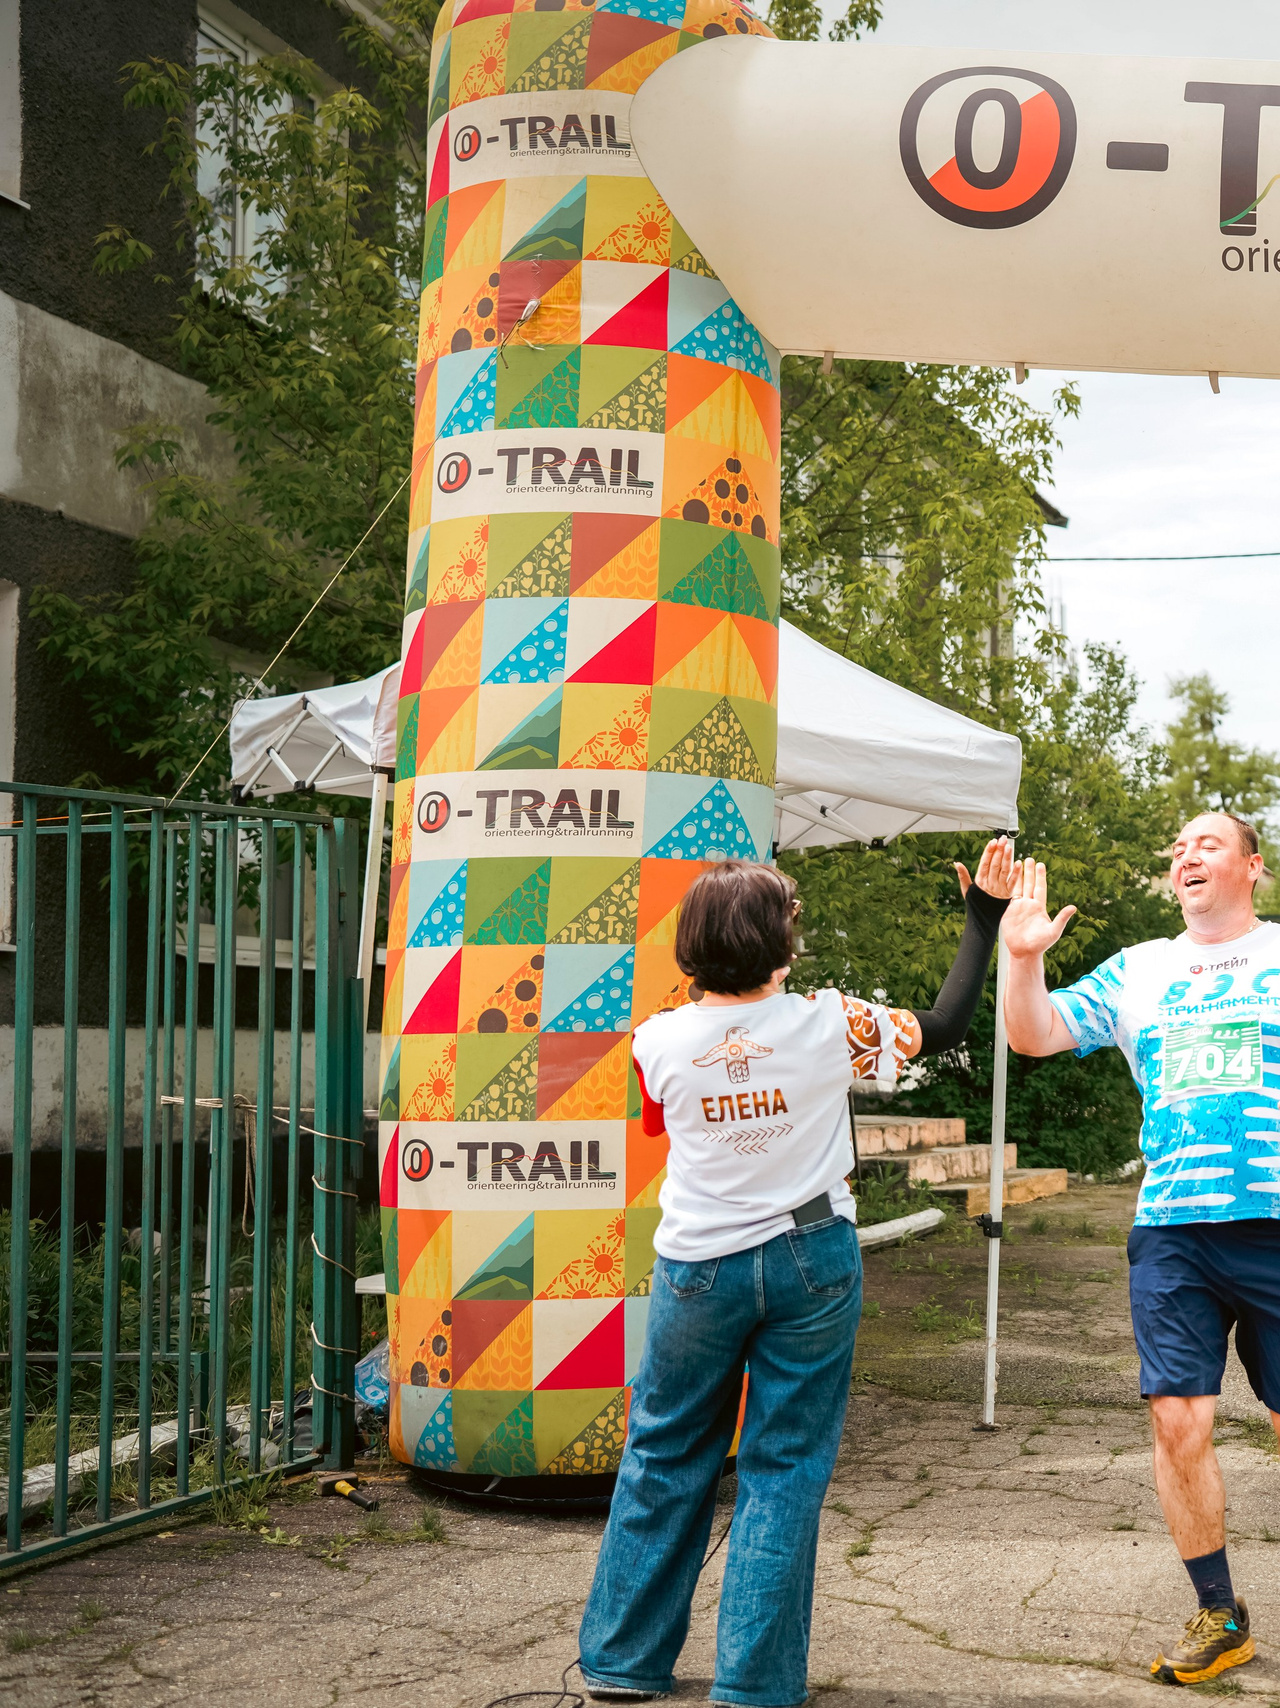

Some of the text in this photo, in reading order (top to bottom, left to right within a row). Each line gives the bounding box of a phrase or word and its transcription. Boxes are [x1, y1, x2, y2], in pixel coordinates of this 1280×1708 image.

[510, 147, 631, 158] orienteering&trailrunning
[506, 484, 653, 499] orienteering&trailrunning
[484, 827, 634, 839] orienteering&trailrunning
[1171, 1044, 1256, 1085] 704
[701, 1088, 789, 1123] ЕЛЕНА
[467, 1180, 616, 1192] orienteering&trailrunning
